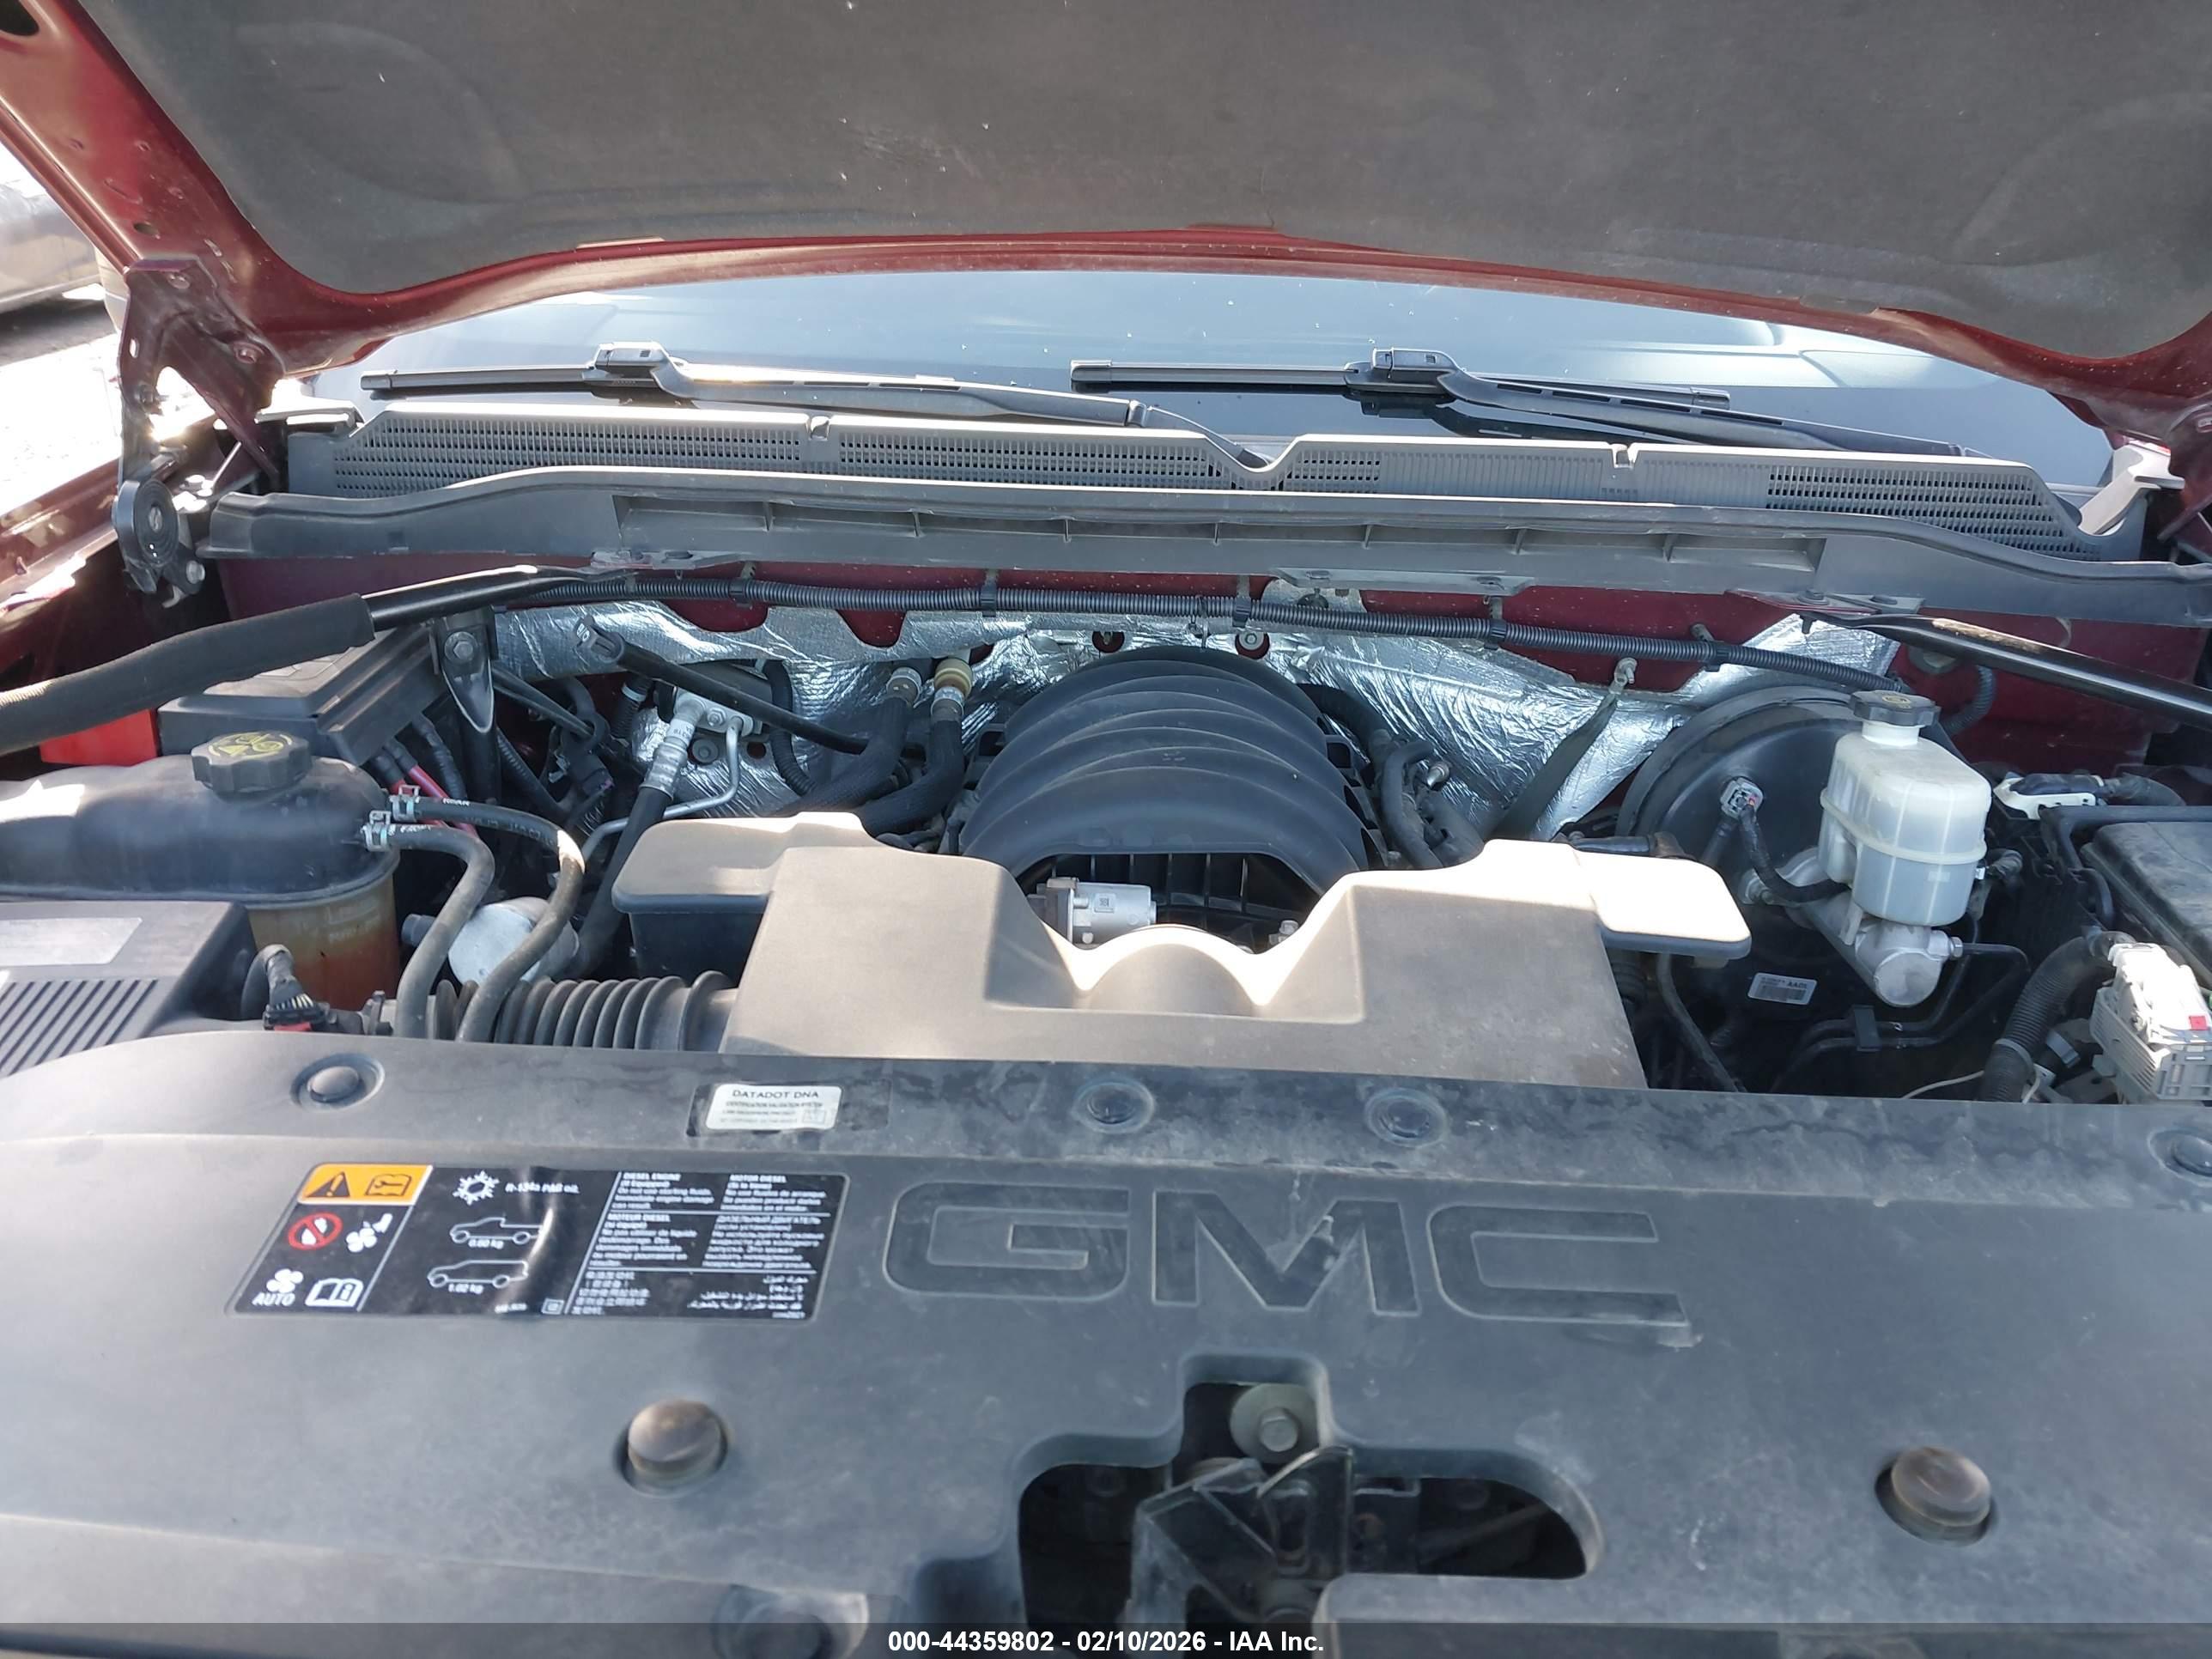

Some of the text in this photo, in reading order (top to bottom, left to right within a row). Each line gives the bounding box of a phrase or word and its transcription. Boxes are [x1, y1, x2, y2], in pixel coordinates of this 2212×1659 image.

[732, 1089, 819, 1099] DATADOT DNA
[884, 1182, 1686, 1324] GMC
[252, 1291, 296, 1307] AUTO
